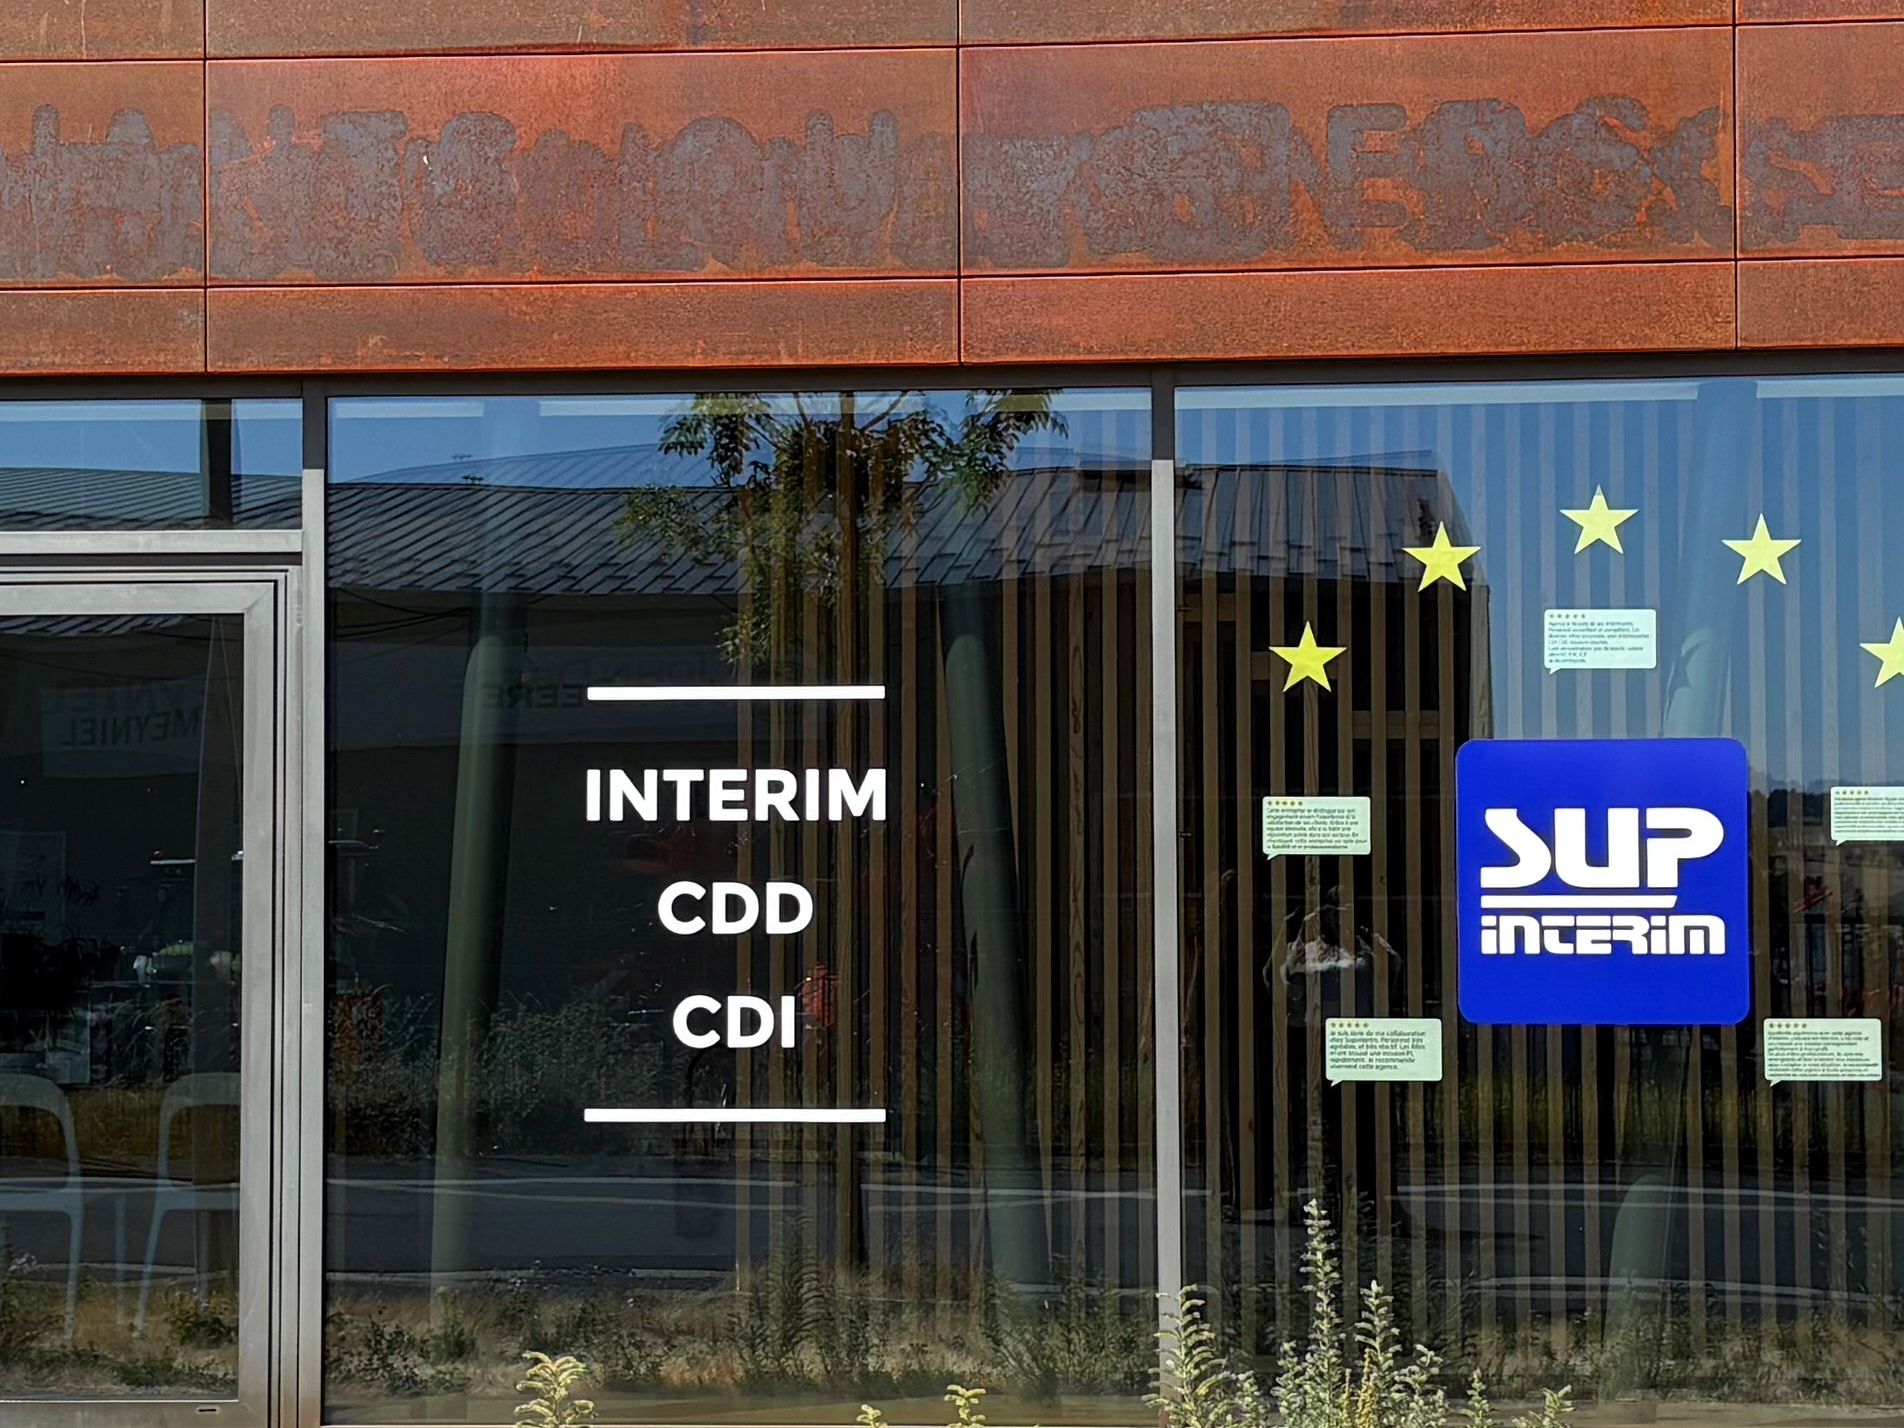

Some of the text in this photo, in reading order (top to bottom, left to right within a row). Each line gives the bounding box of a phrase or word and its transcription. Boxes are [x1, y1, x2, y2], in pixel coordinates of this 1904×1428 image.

[586, 768, 887, 822] INTERIM
[1480, 807, 1725, 888] SUP
[657, 880, 814, 935] CDD
[672, 994, 796, 1049] CDI
